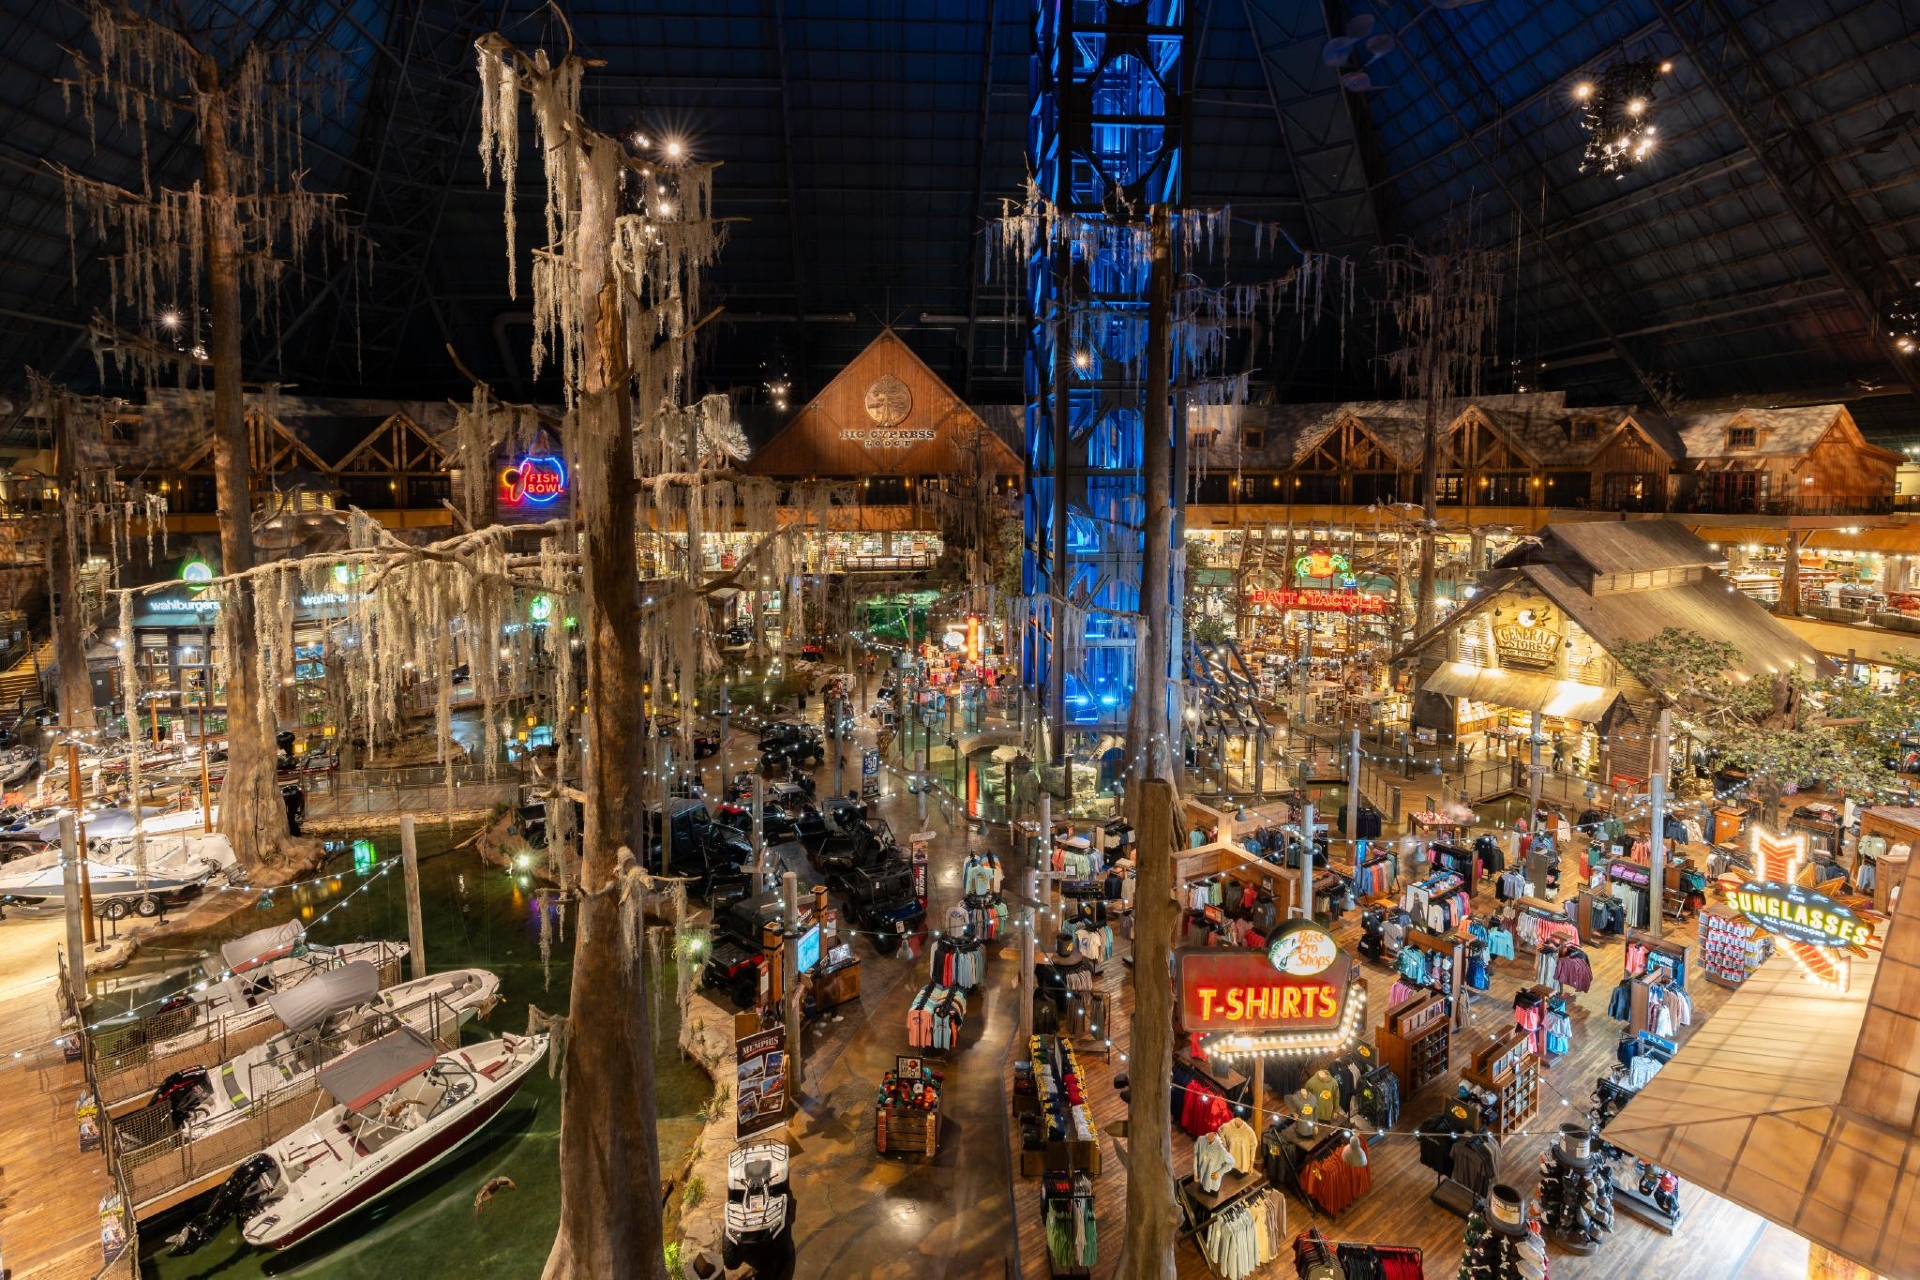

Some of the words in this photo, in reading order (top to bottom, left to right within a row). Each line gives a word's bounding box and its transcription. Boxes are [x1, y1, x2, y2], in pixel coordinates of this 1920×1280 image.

[840, 430, 865, 439] BIG
[870, 430, 935, 439] CYPRESS
[530, 473, 559, 483] FISH
[528, 484, 564, 493] BOWL
[1253, 590, 1298, 604] BAIT
[1308, 592, 1383, 608] TACKLE
[150, 600, 221, 612] wahlburgers
[1501, 626, 1556, 645] GENERAL
[1509, 640, 1543, 652] STORE
[1788, 893, 1806, 903] FOR
[1725, 891, 1869, 946] SUNGLASSES
[1763, 916, 1779, 924] ALL
[1779, 920, 1827, 938] OUTDOORS
[1298, 930, 1326, 942] Bass
[1299, 943, 1319, 954] Pro
[1297, 954, 1332, 968] Shops
[1198, 985, 1337, 1021] T-SHIRTS
[742, 1035, 779, 1054] MEMPHIS
[341, 1154, 389, 1185] TAHOE
